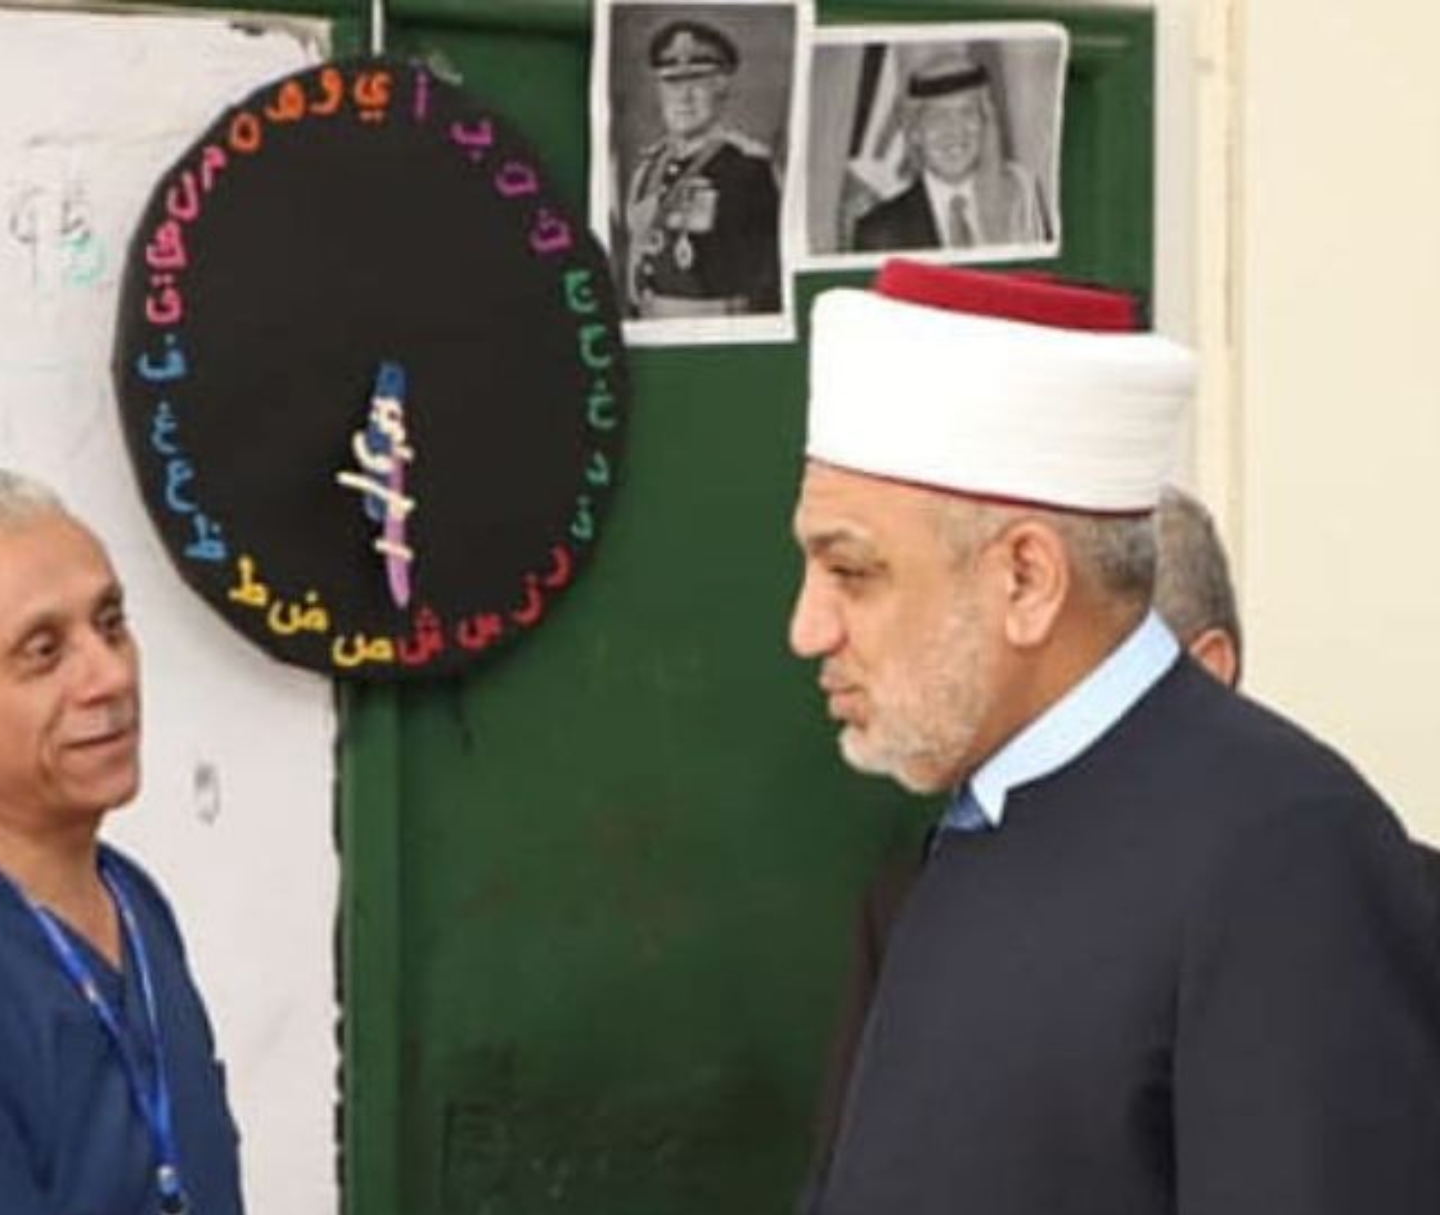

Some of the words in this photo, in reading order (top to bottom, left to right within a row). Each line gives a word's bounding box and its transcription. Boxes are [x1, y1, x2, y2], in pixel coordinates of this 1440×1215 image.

[310, 66, 344, 117] و
[352, 69, 391, 122] ي
[201, 145, 227, 190] م
[166, 170, 199, 221] ل
[146, 273, 181, 325] ق
[564, 269, 597, 313] ج
[138, 336, 185, 381] ف
[579, 323, 611, 367] ح
[152, 401, 177, 453] غ
[587, 379, 616, 428] خ
[165, 460, 197, 512] ع
[184, 514, 227, 561] ظ
[228, 555, 268, 605] ط
[545, 545, 571, 587] ر
[268, 591, 328, 633] ض
[512, 571, 543, 625] ز
[332, 633, 394, 667] ص
